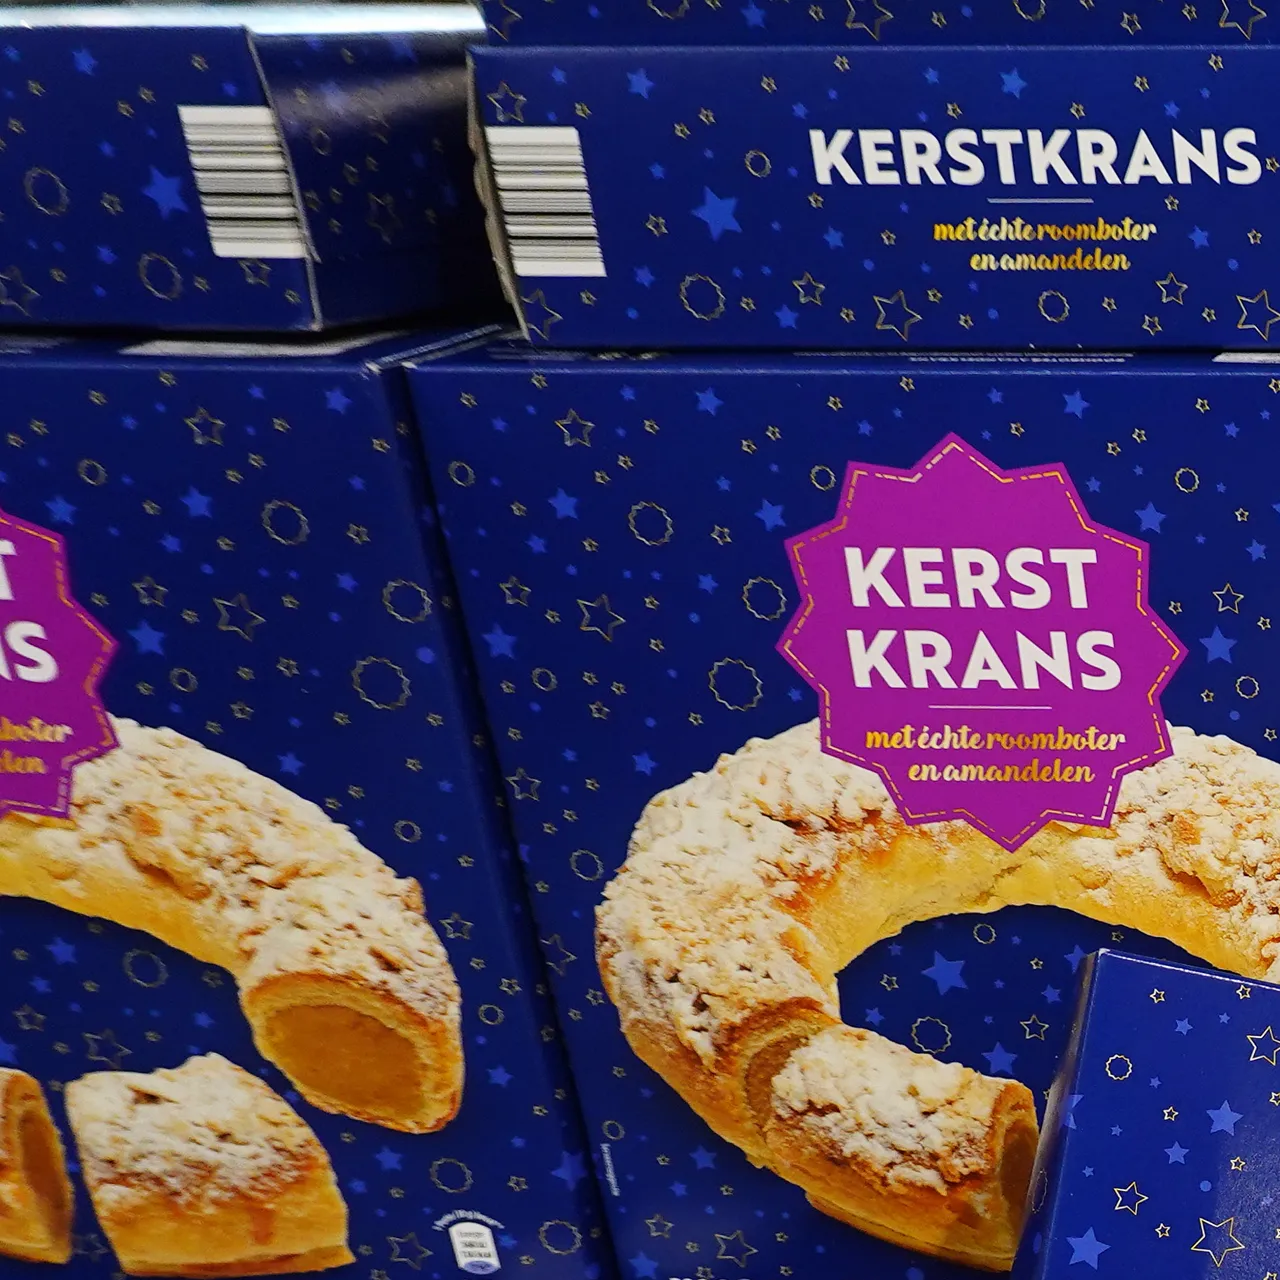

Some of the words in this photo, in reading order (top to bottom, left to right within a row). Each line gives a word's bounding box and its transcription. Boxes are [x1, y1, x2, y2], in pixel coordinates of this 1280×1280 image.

[809, 128, 1262, 185] KERSTKRANS
[934, 217, 976, 241] met
[1037, 217, 1157, 241] roomboter
[970, 251, 999, 271] en
[1000, 247, 1130, 271] amandelen
[844, 547, 1097, 610] KERST
[846, 630, 1122, 691] KRANS
[865, 725, 916, 748] met
[986, 726, 1126, 750] roomboter
[909, 763, 943, 782] en
[943, 758, 1096, 782] amandelen
